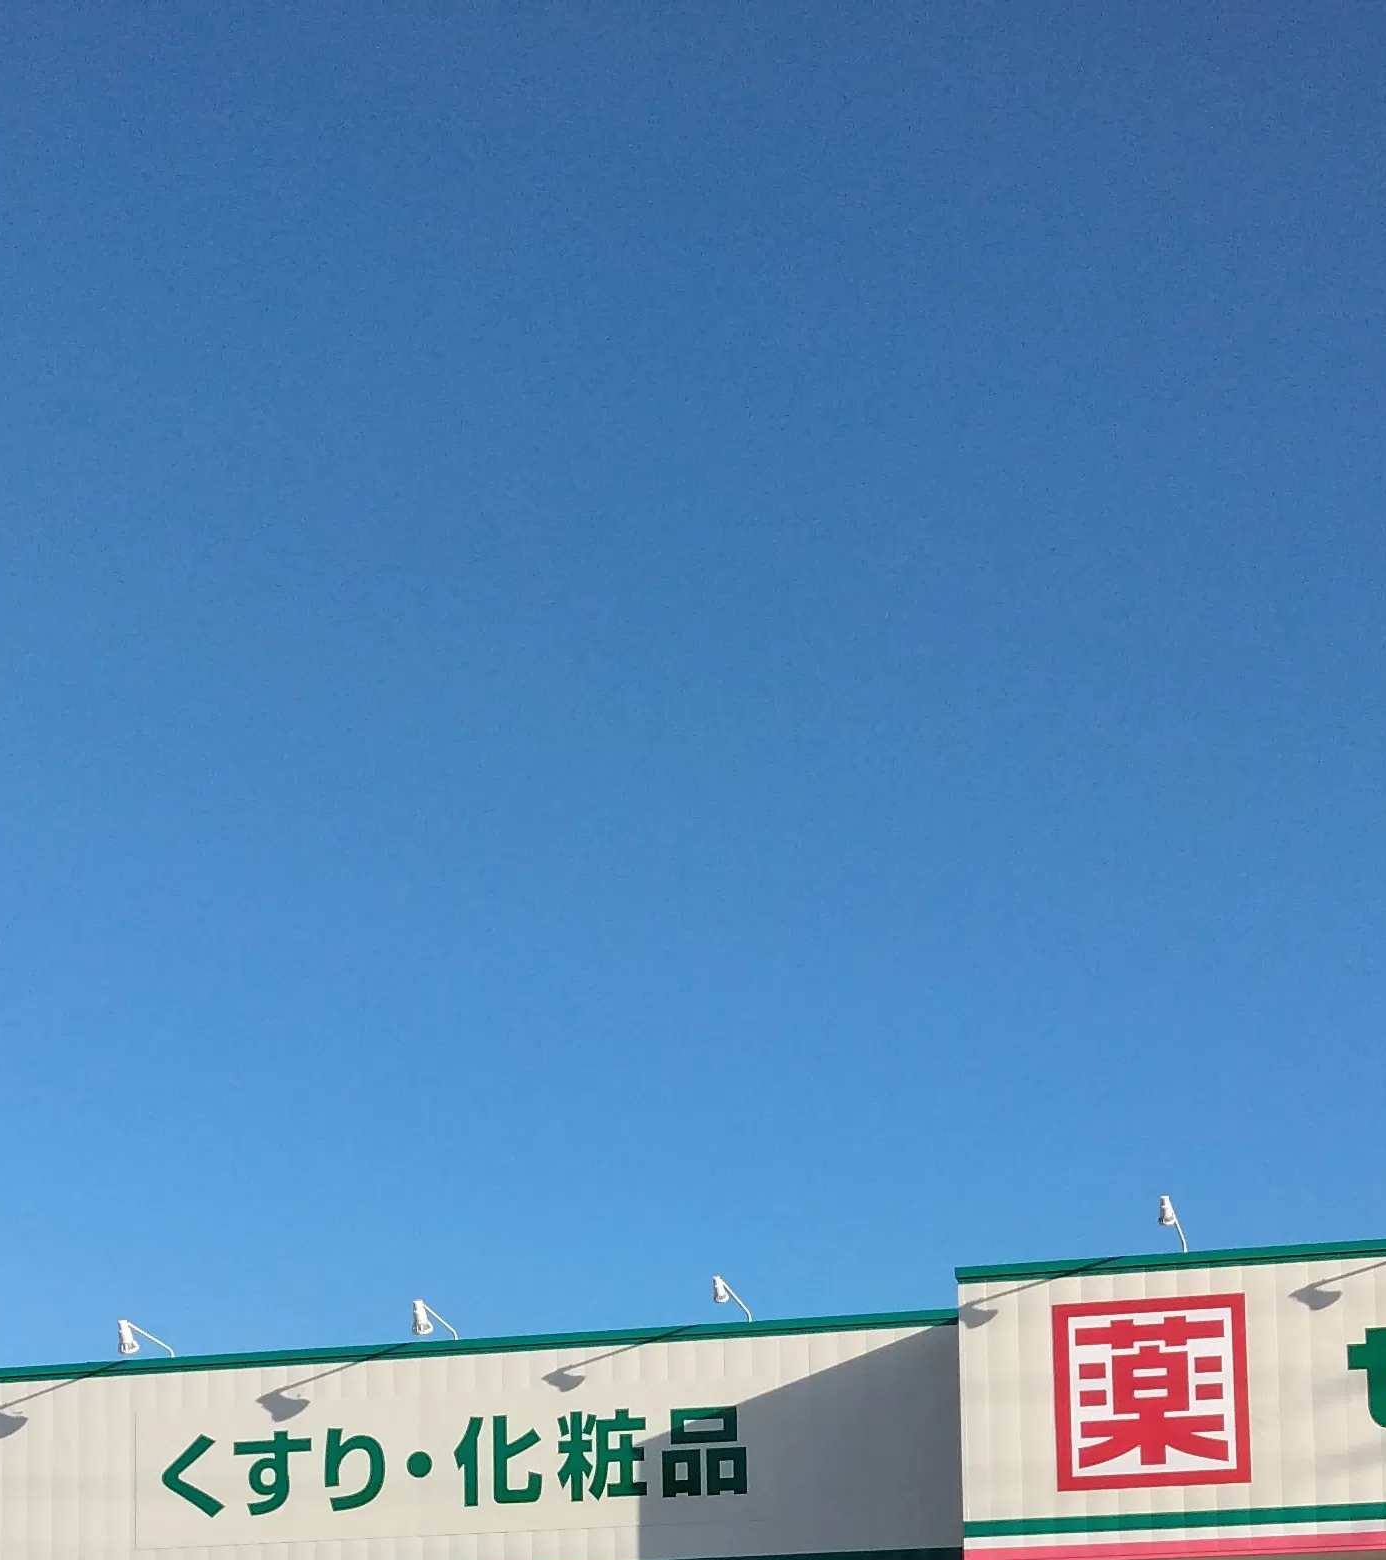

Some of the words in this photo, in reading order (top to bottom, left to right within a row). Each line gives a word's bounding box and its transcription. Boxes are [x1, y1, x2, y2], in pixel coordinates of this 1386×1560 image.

[1076, 1316, 1233, 1468] 薬
[162, 1407, 748, 1517] くすり・化粧品
